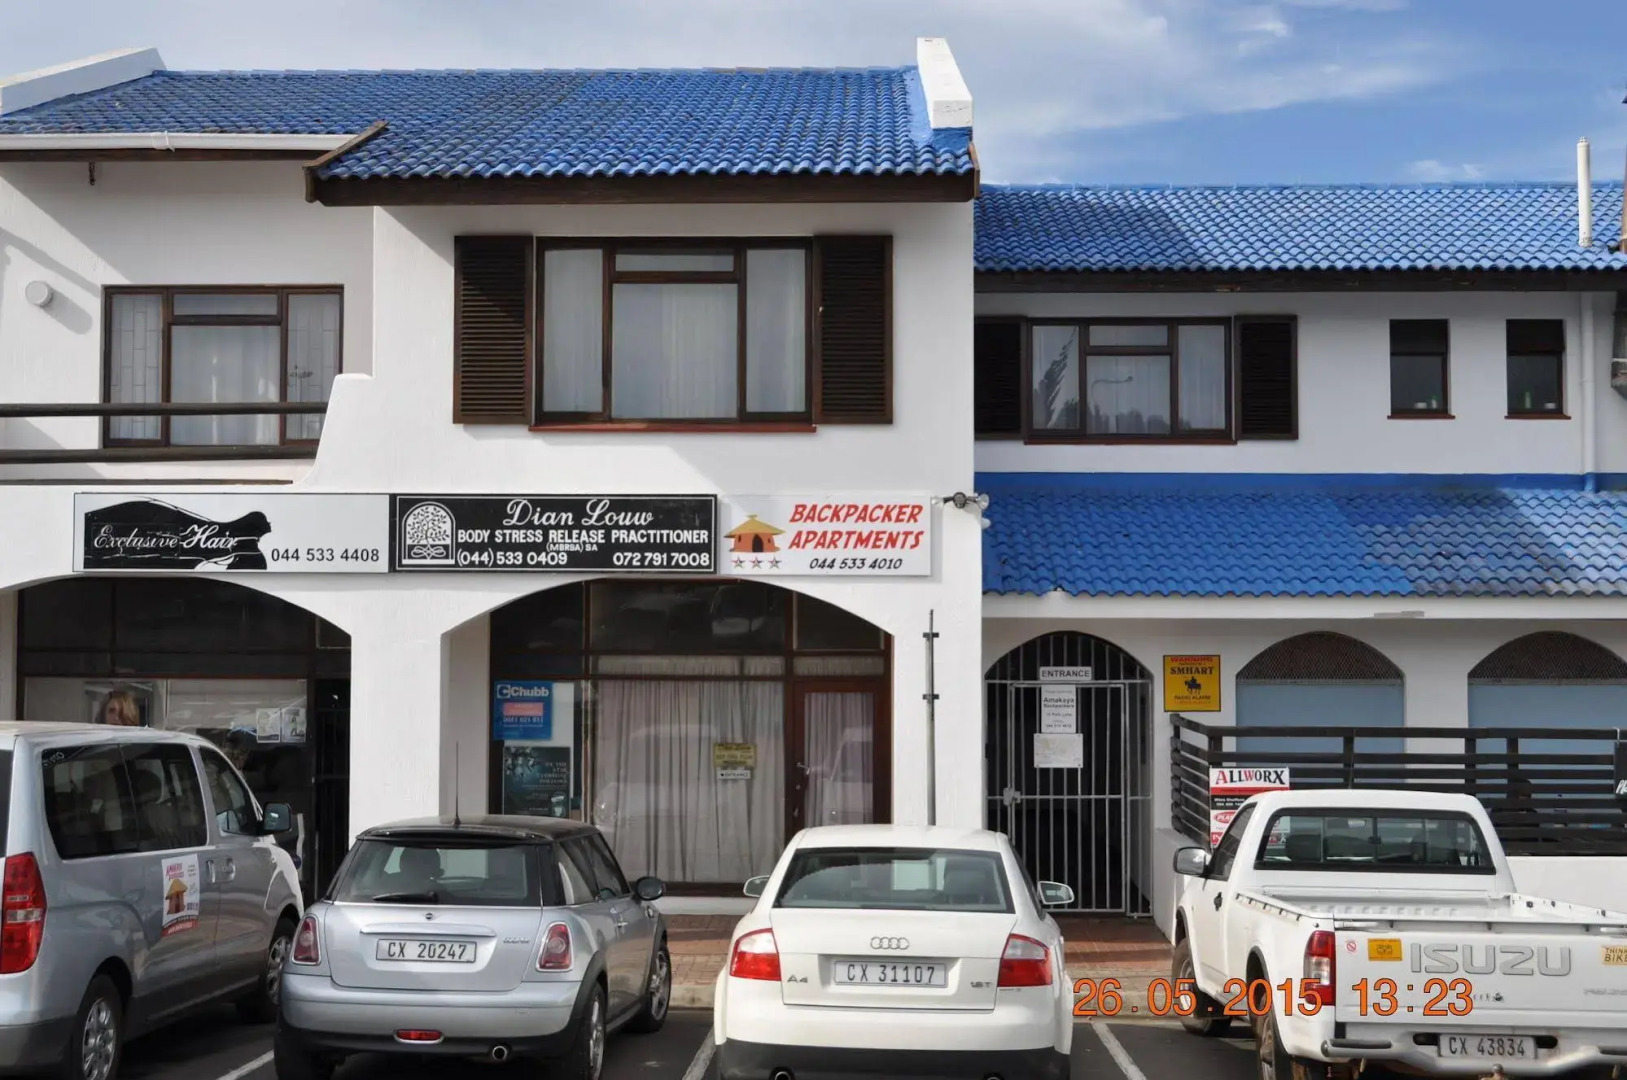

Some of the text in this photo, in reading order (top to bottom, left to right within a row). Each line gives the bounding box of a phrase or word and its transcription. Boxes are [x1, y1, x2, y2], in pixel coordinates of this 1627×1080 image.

[502, 498, 654, 526] Dian Louw
[788, 504, 924, 523] BACKPACKER
[94, 524, 237, 554] Exclusive Hair
[457, 529, 709, 544] BODY STRESS RELEASE PRACTITIONER
[787, 530, 925, 550] APARTMENTS
[271, 548, 380, 562] 044 533 4408
[585, 544, 598, 552] SA
[456, 548, 568, 568] (044) 533 0409
[613, 552, 710, 566] 072 791 7008
[809, 558, 902, 570] 044 533 4010
[1041, 669, 1090, 678] ENTRANCE
[1170, 666, 1214, 675] SMHART
[510, 686, 549, 697] Chubb
[1043, 696, 1074, 704] Amakaya
[1215, 769, 1285, 785] ALLWORX
[387, 942, 467, 960] CX 20247
[1410, 942, 1571, 976] ISUZU
[787, 974, 809, 984] A4
[847, 964, 935, 984] CX 31107
[1447, 1035, 1526, 1057] CX 43834
